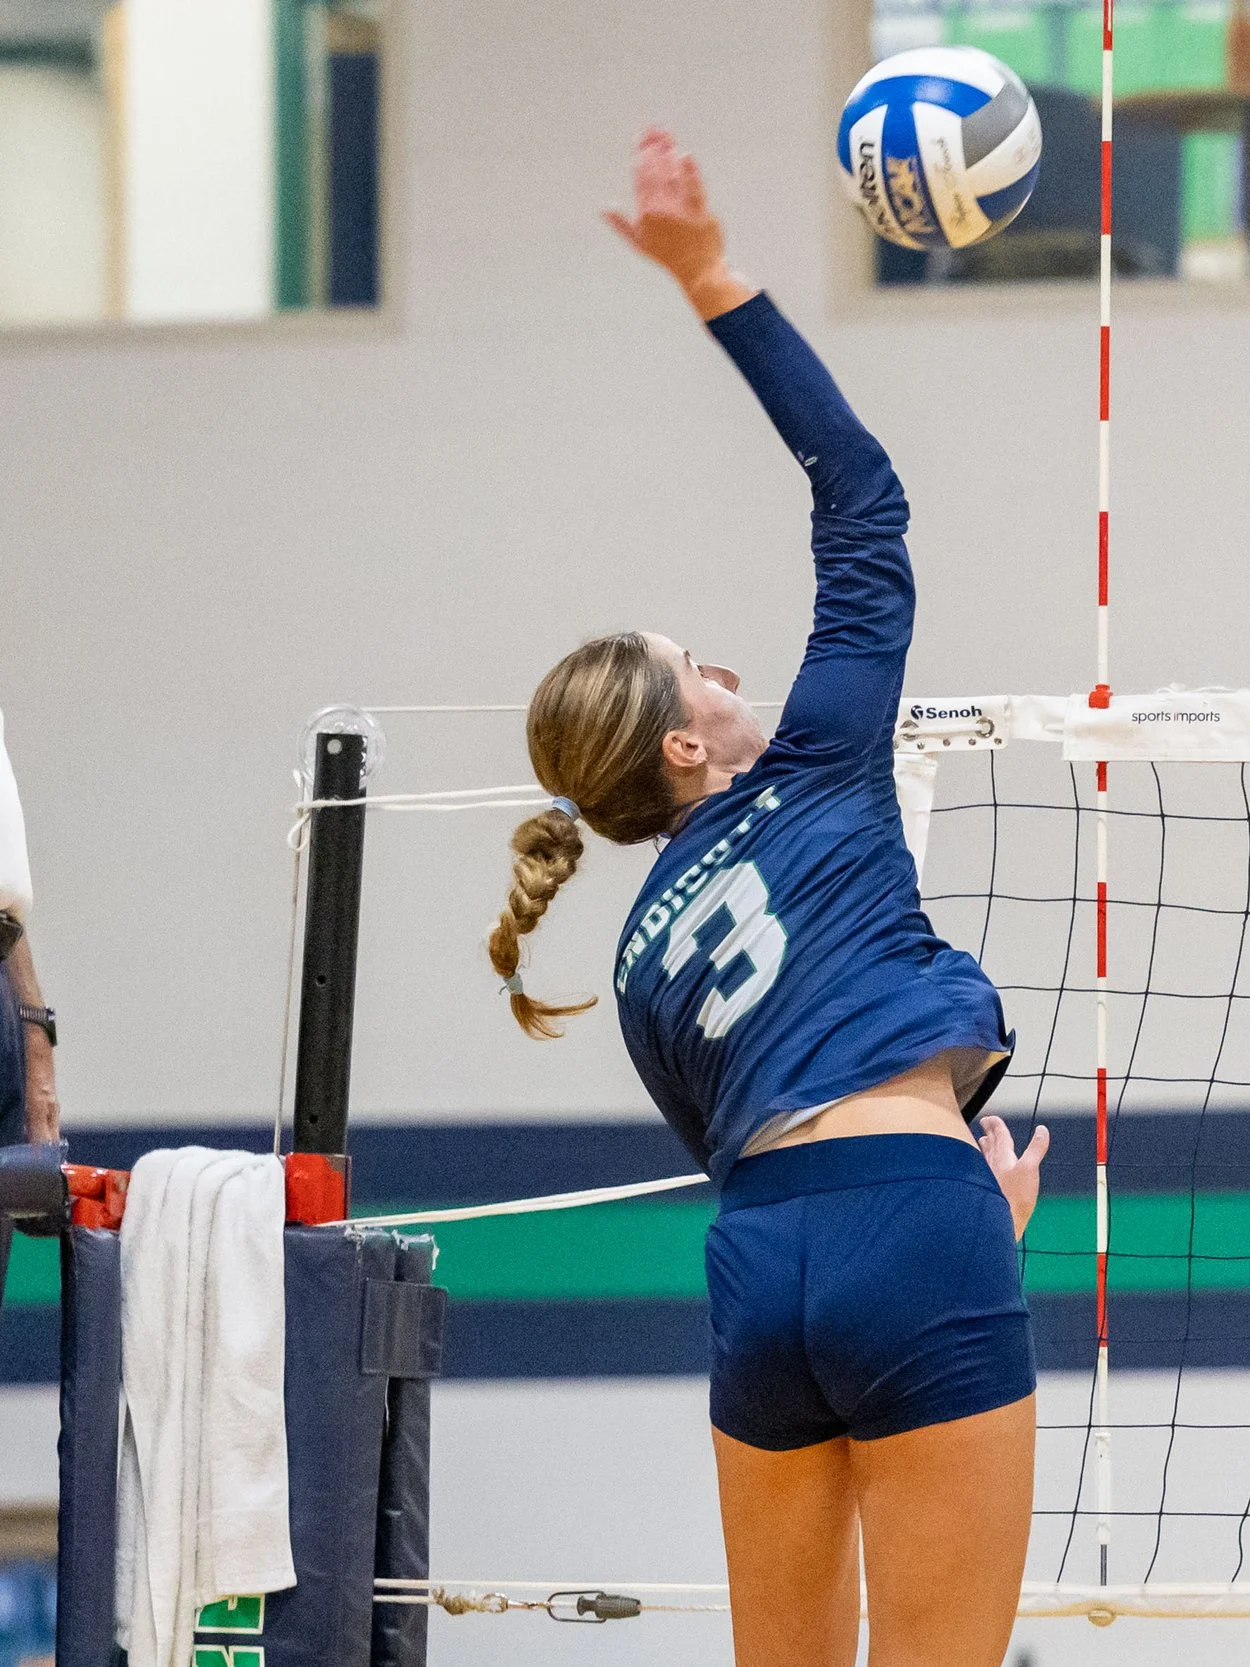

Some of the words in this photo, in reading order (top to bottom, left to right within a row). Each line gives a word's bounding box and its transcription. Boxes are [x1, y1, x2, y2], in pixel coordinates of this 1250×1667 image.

[926, 705, 982, 719] Senoh
[1131, 711, 1171, 724] sports
[1173, 711, 1220, 722] imports
[661, 859, 789, 1040] 3
